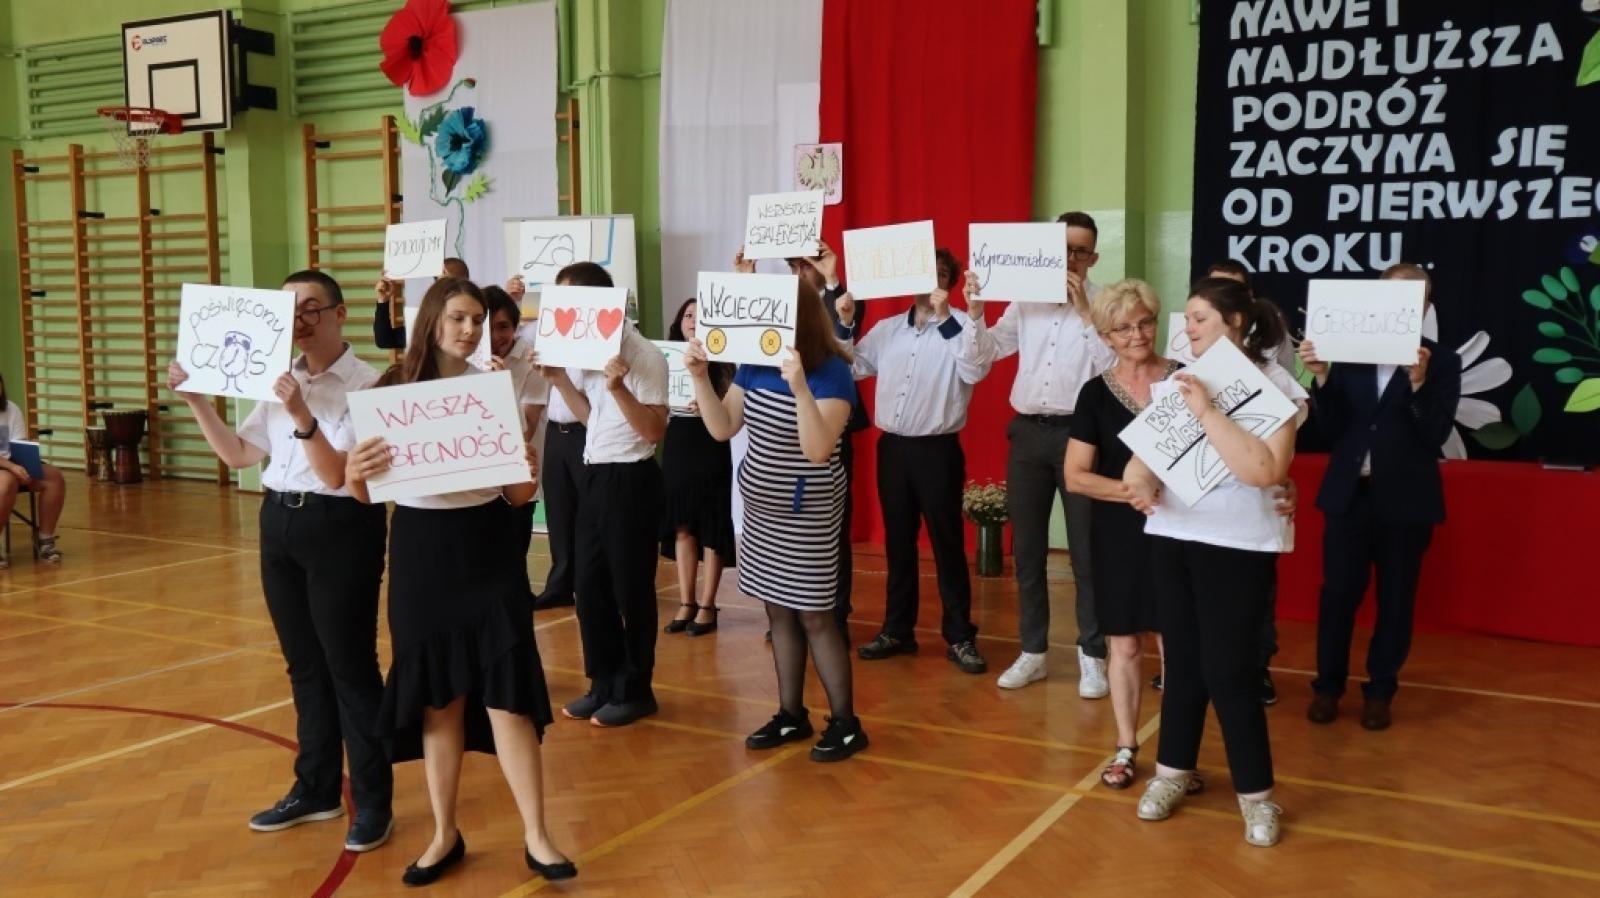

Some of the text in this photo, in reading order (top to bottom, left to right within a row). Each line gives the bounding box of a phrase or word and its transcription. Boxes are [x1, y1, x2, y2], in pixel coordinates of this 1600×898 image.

[1227, 20, 1564, 88] NAJDŁUŻSZA
[1232, 76, 1448, 132] PODRÓŻ
[1229, 124, 1569, 178] ZACZYNA SIĘ
[1222, 176, 1600, 227] OD PIERWSZE
[376, 392, 494, 428] WASZĄ
[384, 423, 519, 468] BECNOŚĆ
